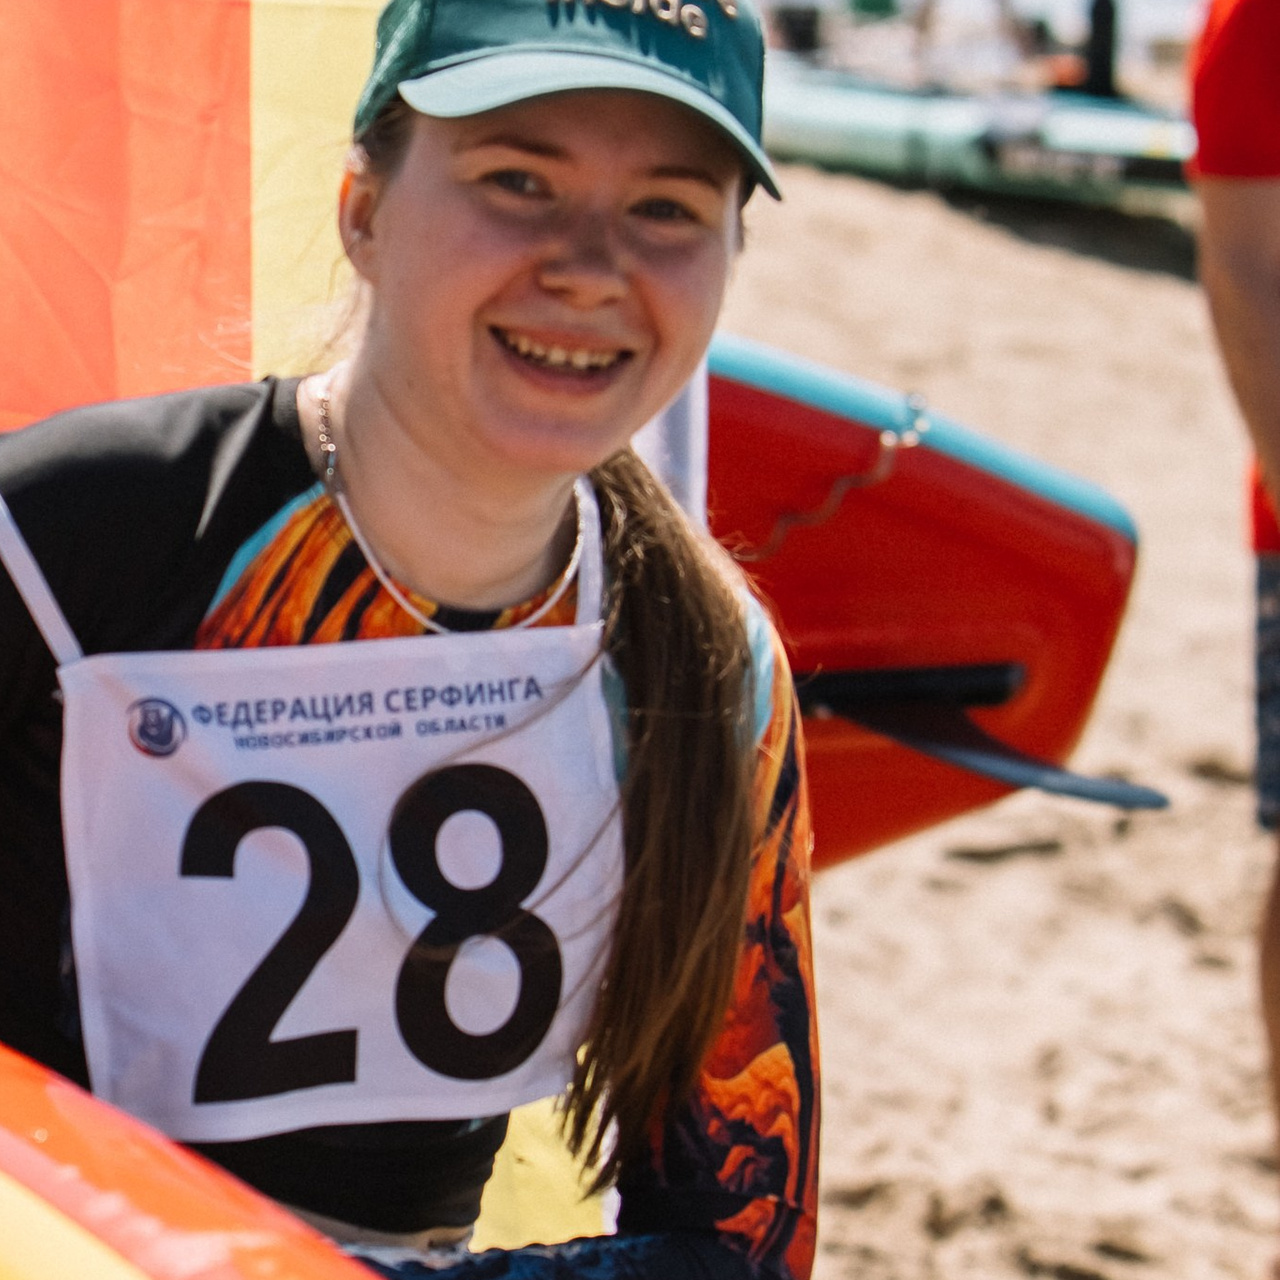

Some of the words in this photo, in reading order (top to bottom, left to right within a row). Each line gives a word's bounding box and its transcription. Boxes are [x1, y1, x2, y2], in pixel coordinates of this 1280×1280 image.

[192, 690, 374, 730] ФЕДЕРАЦИЯ
[384, 676, 543, 713] СЕРФИНГА
[416, 713, 506, 737] ОБЛАСТИ
[179, 762, 563, 1106] 28
